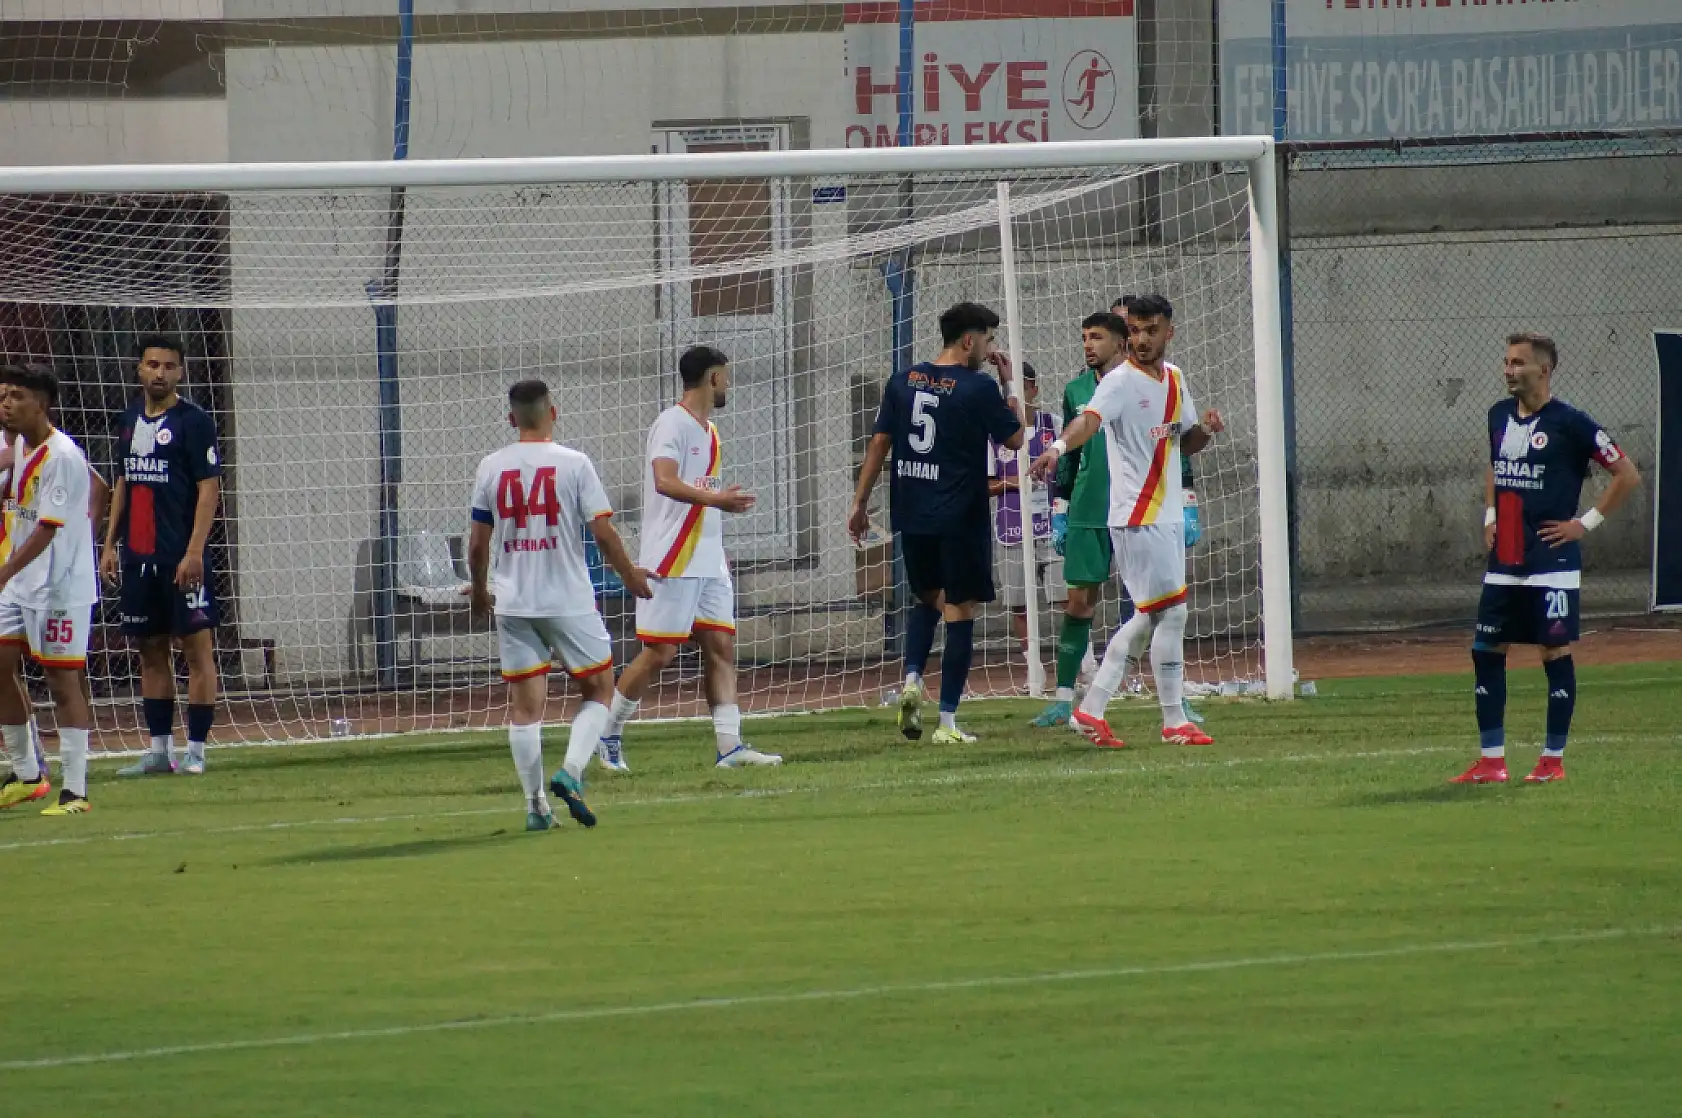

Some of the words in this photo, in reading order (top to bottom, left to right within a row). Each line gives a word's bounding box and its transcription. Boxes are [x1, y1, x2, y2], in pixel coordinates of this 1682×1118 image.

[1236, 44, 1344, 135] FEHİYE
[908, 390, 940, 454] 5
[123, 457, 169, 472] ESNAF
[496, 466, 561, 529] 44
[1544, 589, 1569, 619] 20
[44, 618, 74, 643] 55
